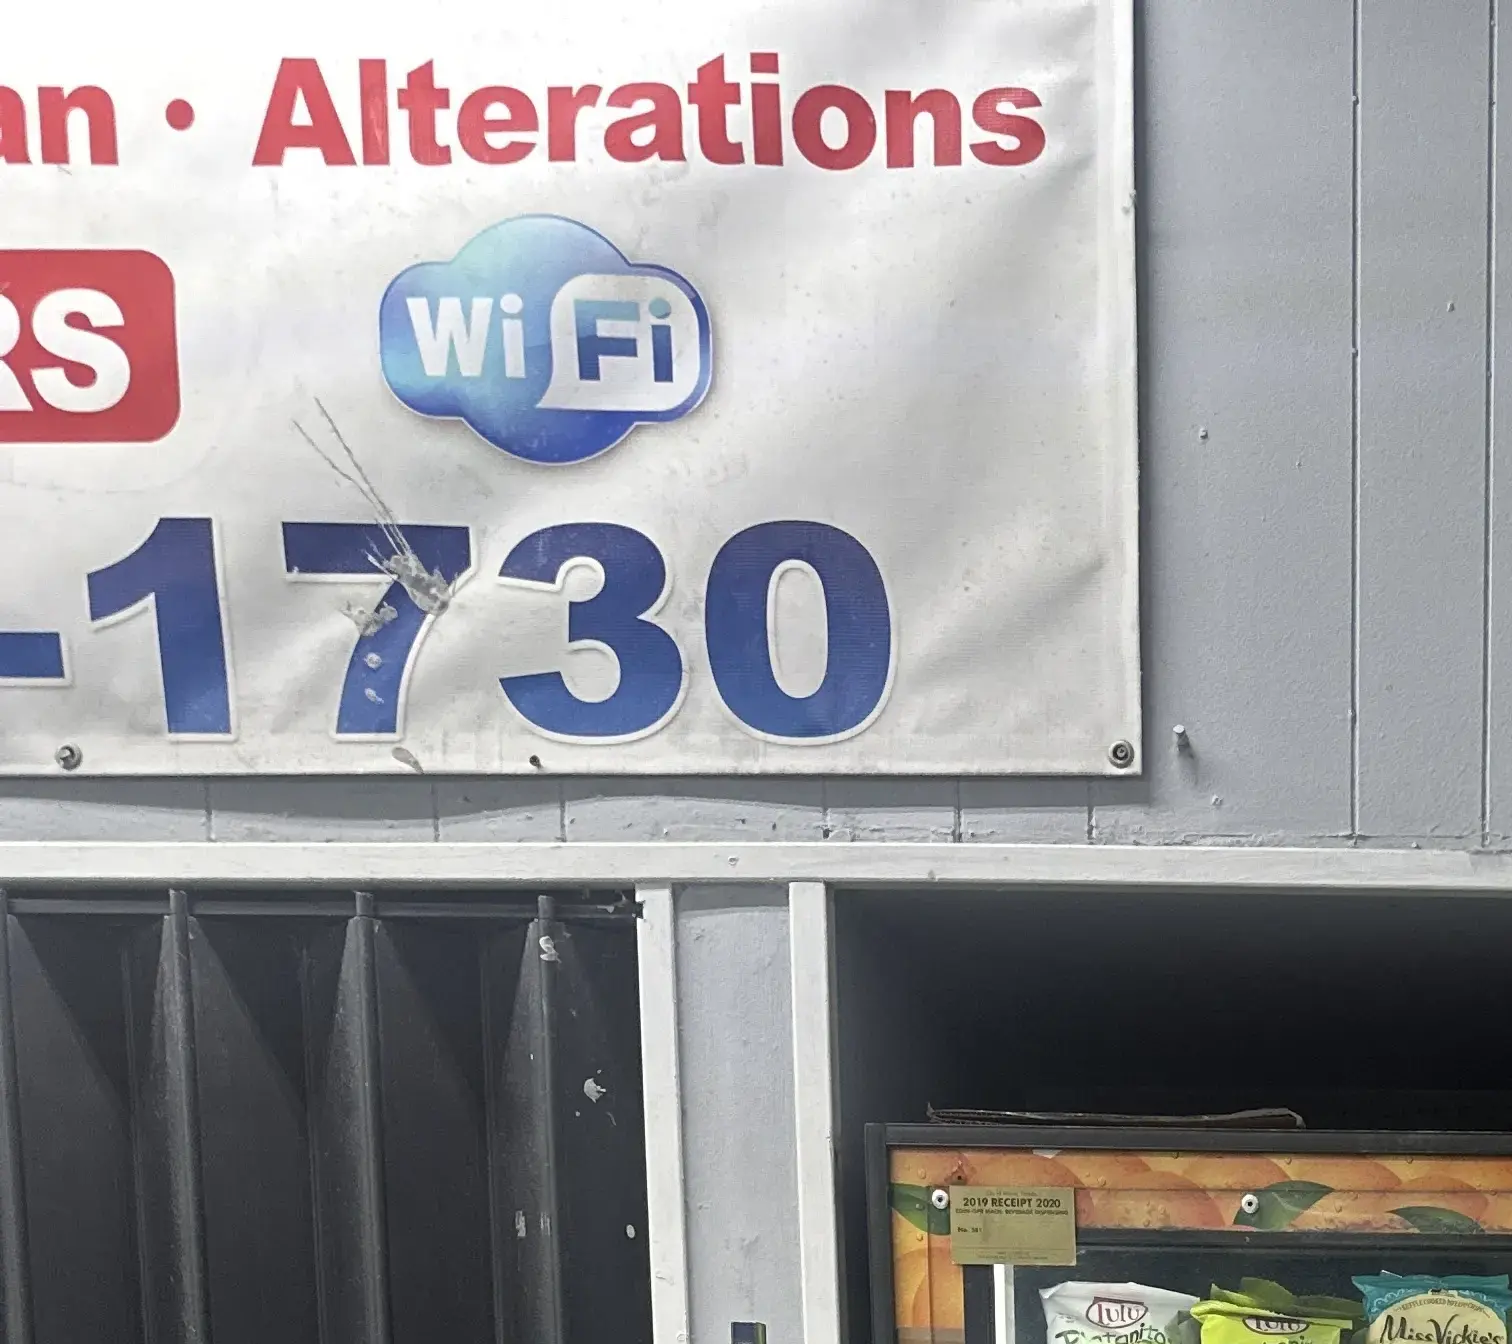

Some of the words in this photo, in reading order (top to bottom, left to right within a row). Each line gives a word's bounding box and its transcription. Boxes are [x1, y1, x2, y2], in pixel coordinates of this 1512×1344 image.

[251, 53, 1046, 170] Alterations
[963, 1197, 988, 1207] 2019
[991, 1197, 1032, 1208] RECEIPT
[1036, 1198, 1061, 1208] 2020
[1379, 1314, 1434, 1343] Miss
